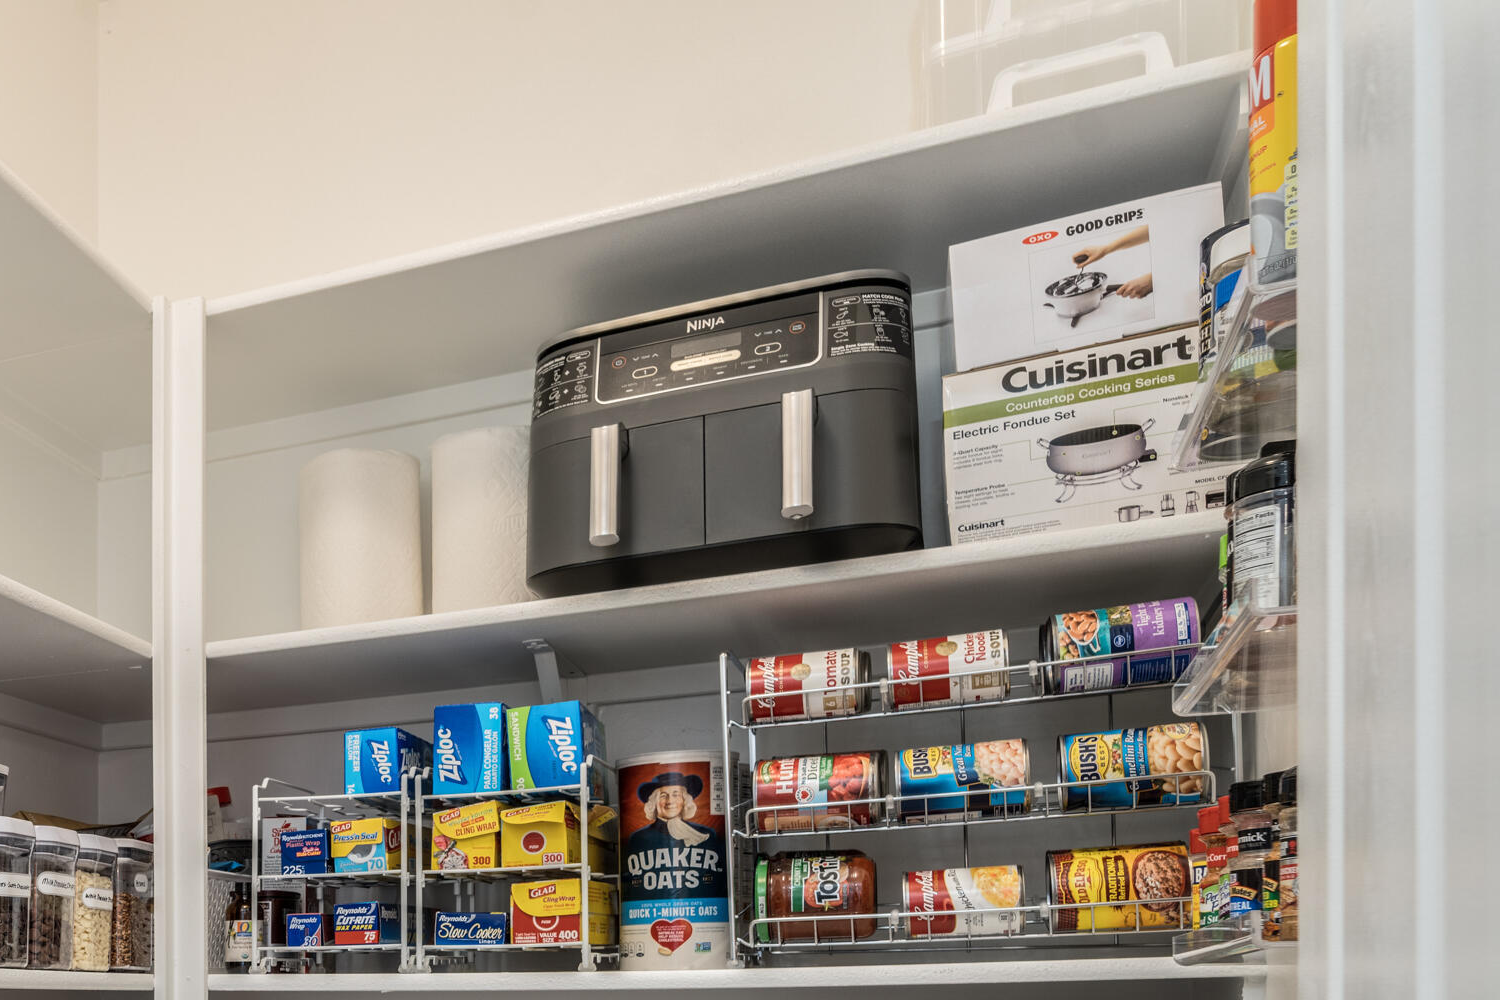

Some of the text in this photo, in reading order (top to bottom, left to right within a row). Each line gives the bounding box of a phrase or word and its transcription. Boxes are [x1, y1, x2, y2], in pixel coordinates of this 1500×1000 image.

[1066, 208, 1143, 236] GOOD GRIPS
[1029, 231, 1051, 244] OXO
[686, 315, 725, 334] NINJA
[1001, 334, 1192, 393] Cuisinart
[1005, 373, 1176, 413] Countertop Cooking Series
[952, 409, 1076, 440] Electric Fondue Set
[957, 518, 1005, 533] Cuisinart
[1153, 606, 1165, 637] kidney
[841, 653, 851, 687] SOUP
[489, 706, 499, 720] 38
[510, 711, 521, 761] SANDWICH
[547, 716, 579, 773] Ziploc
[371, 740, 392, 784] Ziploc
[436, 727, 463, 785] Ziploc
[484, 729, 494, 790] PARA CONGELAR
[440, 809, 462, 825] GLAD
[331, 823, 351, 834] GLAD
[360, 831, 378, 841] Seal
[455, 821, 498, 837] CLING WRAP
[368, 860, 384, 870] 70
[472, 855, 492, 866] 300
[543, 853, 564, 864] 300
[627, 847, 720, 877] QUAKER
[283, 865, 301, 876] 225
[643, 870, 701, 890] OATS
[1106, 857, 1116, 902] TRADITIONAL
[530, 885, 557, 898] GLAD
[336, 905, 368, 916] Reynolds
[628, 905, 718, 919] QUICK 1-MINUTE OATS
[291, 916, 318, 924] Reynolds
[335, 915, 376, 925] CUT-RITE
[438, 914, 468, 923] Reynolds
[288, 922, 306, 931] Wrap
[351, 923, 373, 931] PAPER
[438, 922, 503, 940] Slow Cooker
[363, 931, 376, 941] 75
[540, 929, 578, 940] VALUE 400
